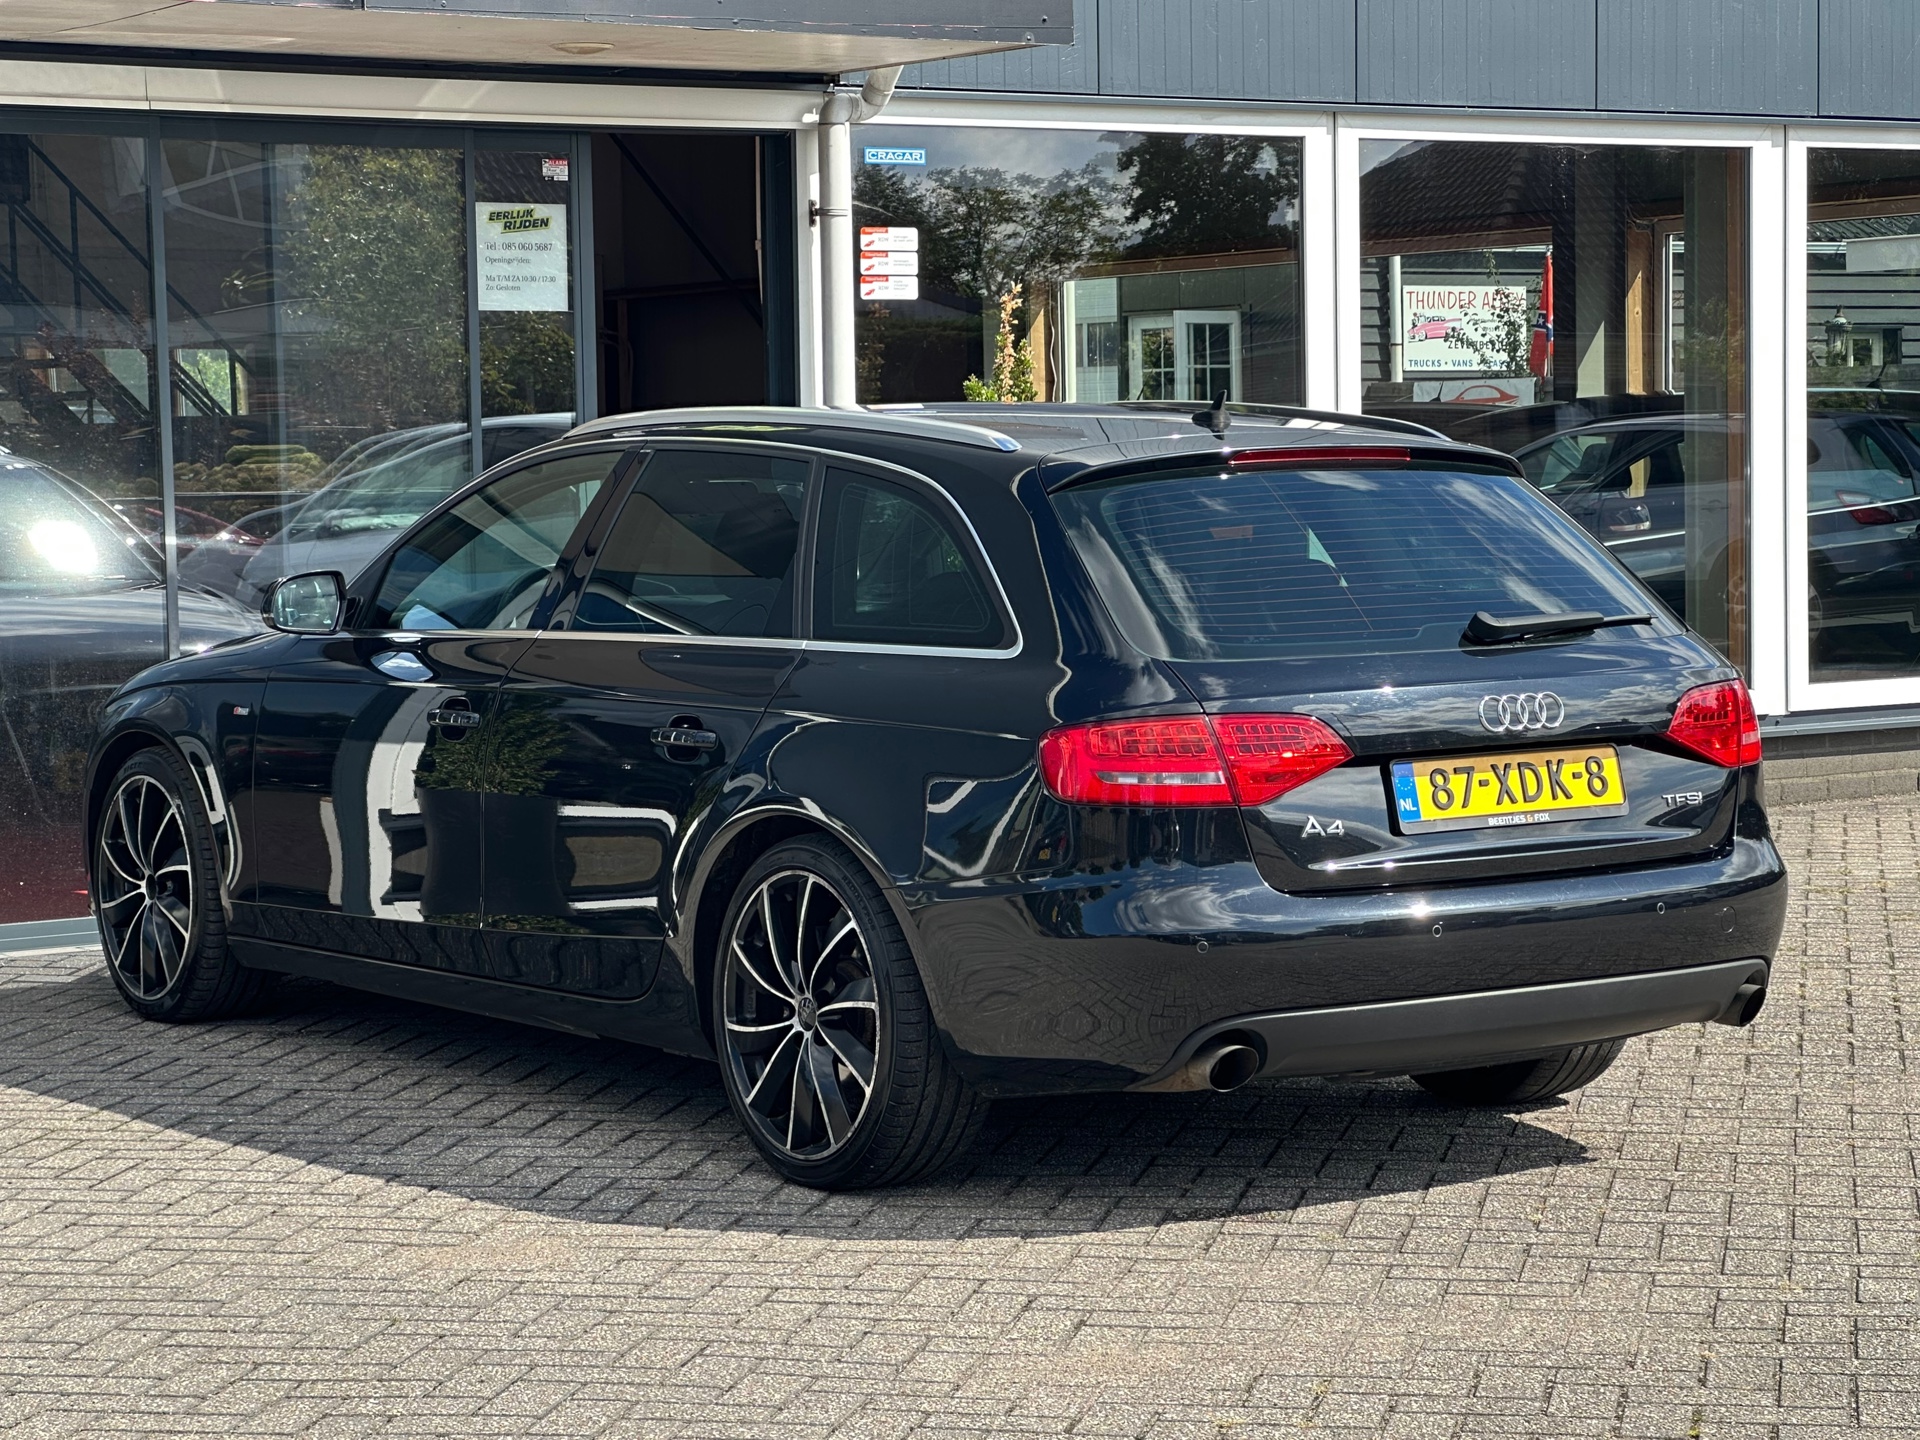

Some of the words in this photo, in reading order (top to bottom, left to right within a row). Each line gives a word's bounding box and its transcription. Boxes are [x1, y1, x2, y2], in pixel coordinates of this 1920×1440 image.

[868, 151, 921, 160] CRAGAR
[488, 208, 534, 221] EERLIJK
[503, 218, 549, 230] RIJDEN
[501, 242, 516, 251] 085
[518, 242, 533, 251] 060
[534, 243, 553, 251] 5687
[1406, 290, 1476, 310] THUNDER
[1408, 359, 1442, 368] TRUCKS
[1451, 359, 1473, 368] VANS
[1429, 755, 1609, 811] 87-XDK-8
[1400, 798, 1417, 812] NL
[1661, 791, 1703, 807] TFSI
[1488, 814, 1526, 826] BEENTJES
[1534, 813, 1550, 822] FOX
[1301, 815, 1345, 838] A4
